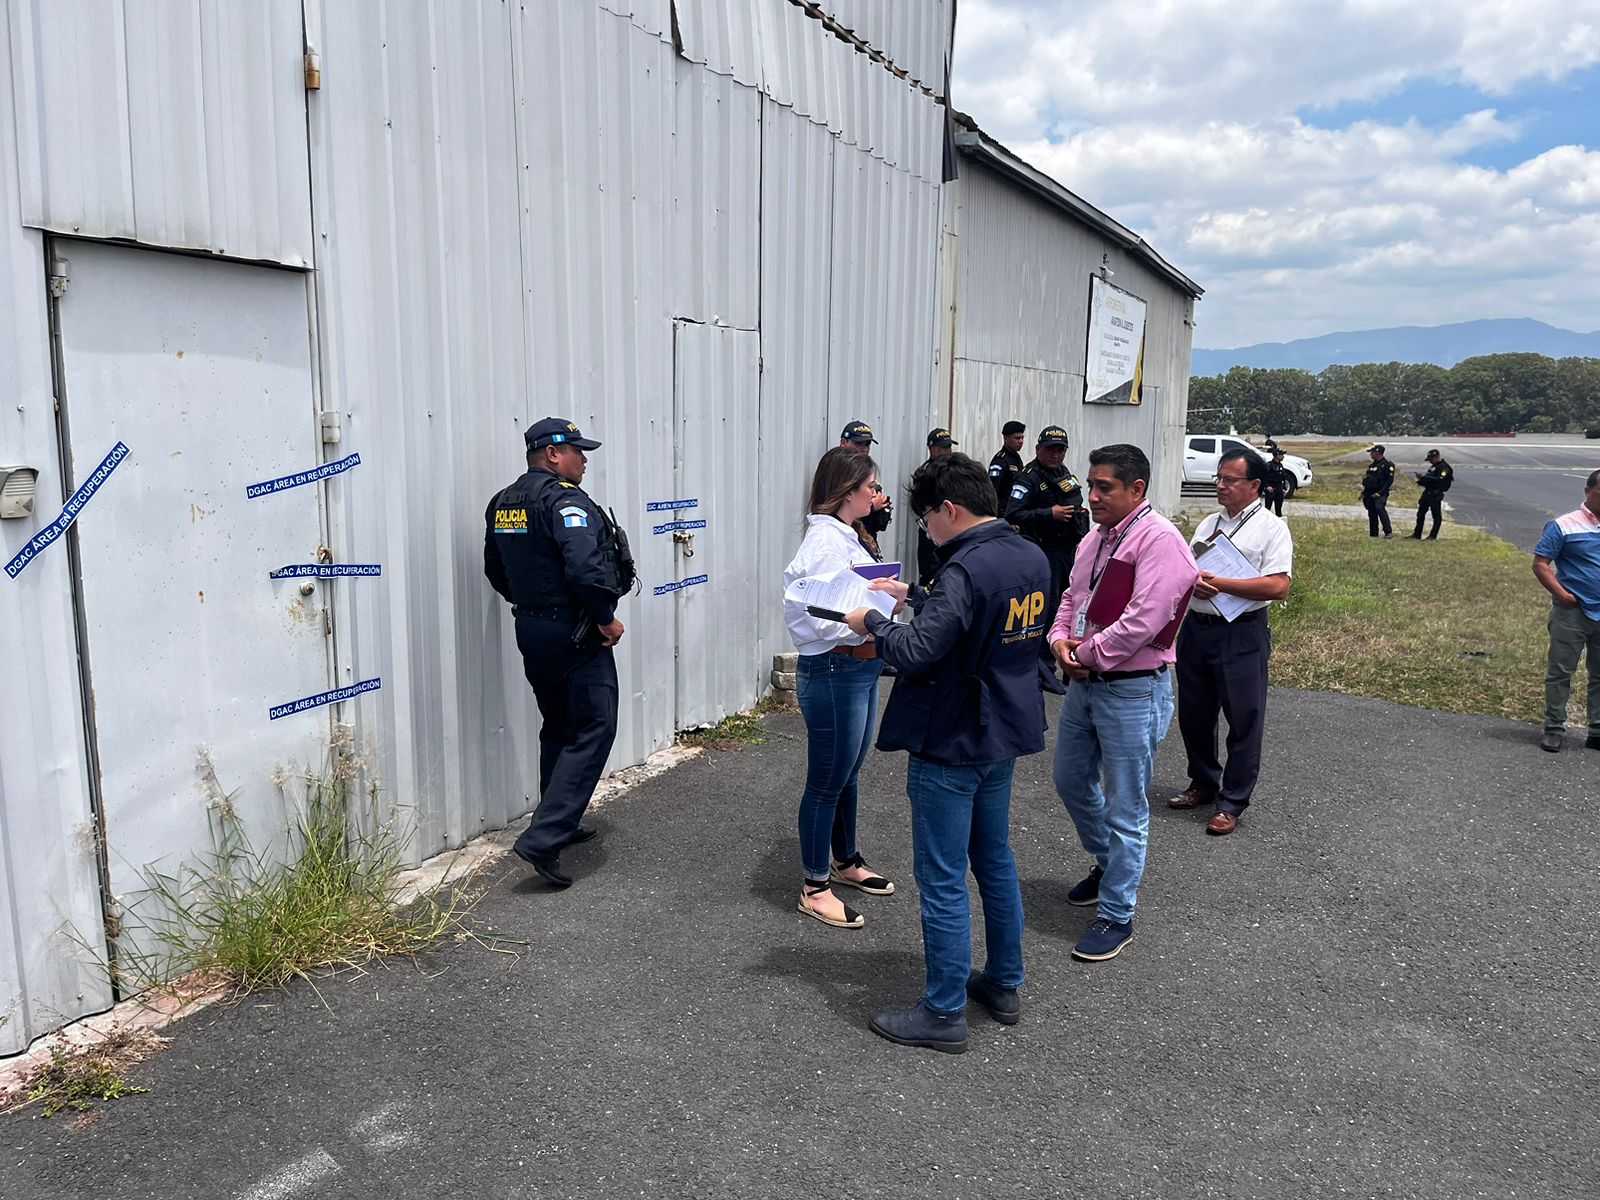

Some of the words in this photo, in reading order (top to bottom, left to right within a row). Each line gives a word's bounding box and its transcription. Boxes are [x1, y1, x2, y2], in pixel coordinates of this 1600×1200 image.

[248, 484, 272, 497] DGAC
[274, 478, 296, 490] ÁREA
[296, 475, 307, 484] EN
[8, 549, 33, 576] DGAC
[32, 525, 62, 551] ÁREA
[59, 512, 72, 528] EN
[68, 444, 127, 514] RECUPERACIÓN
[296, 566, 318, 576] ÁREA
[320, 568, 331, 576] EN
[1004, 591, 1044, 631] MP
[270, 705, 293, 718] DGAC
[294, 700, 315, 710] ÁREA
[316, 695, 326, 704] EN
[328, 680, 380, 702] RECUPERACIÓN
